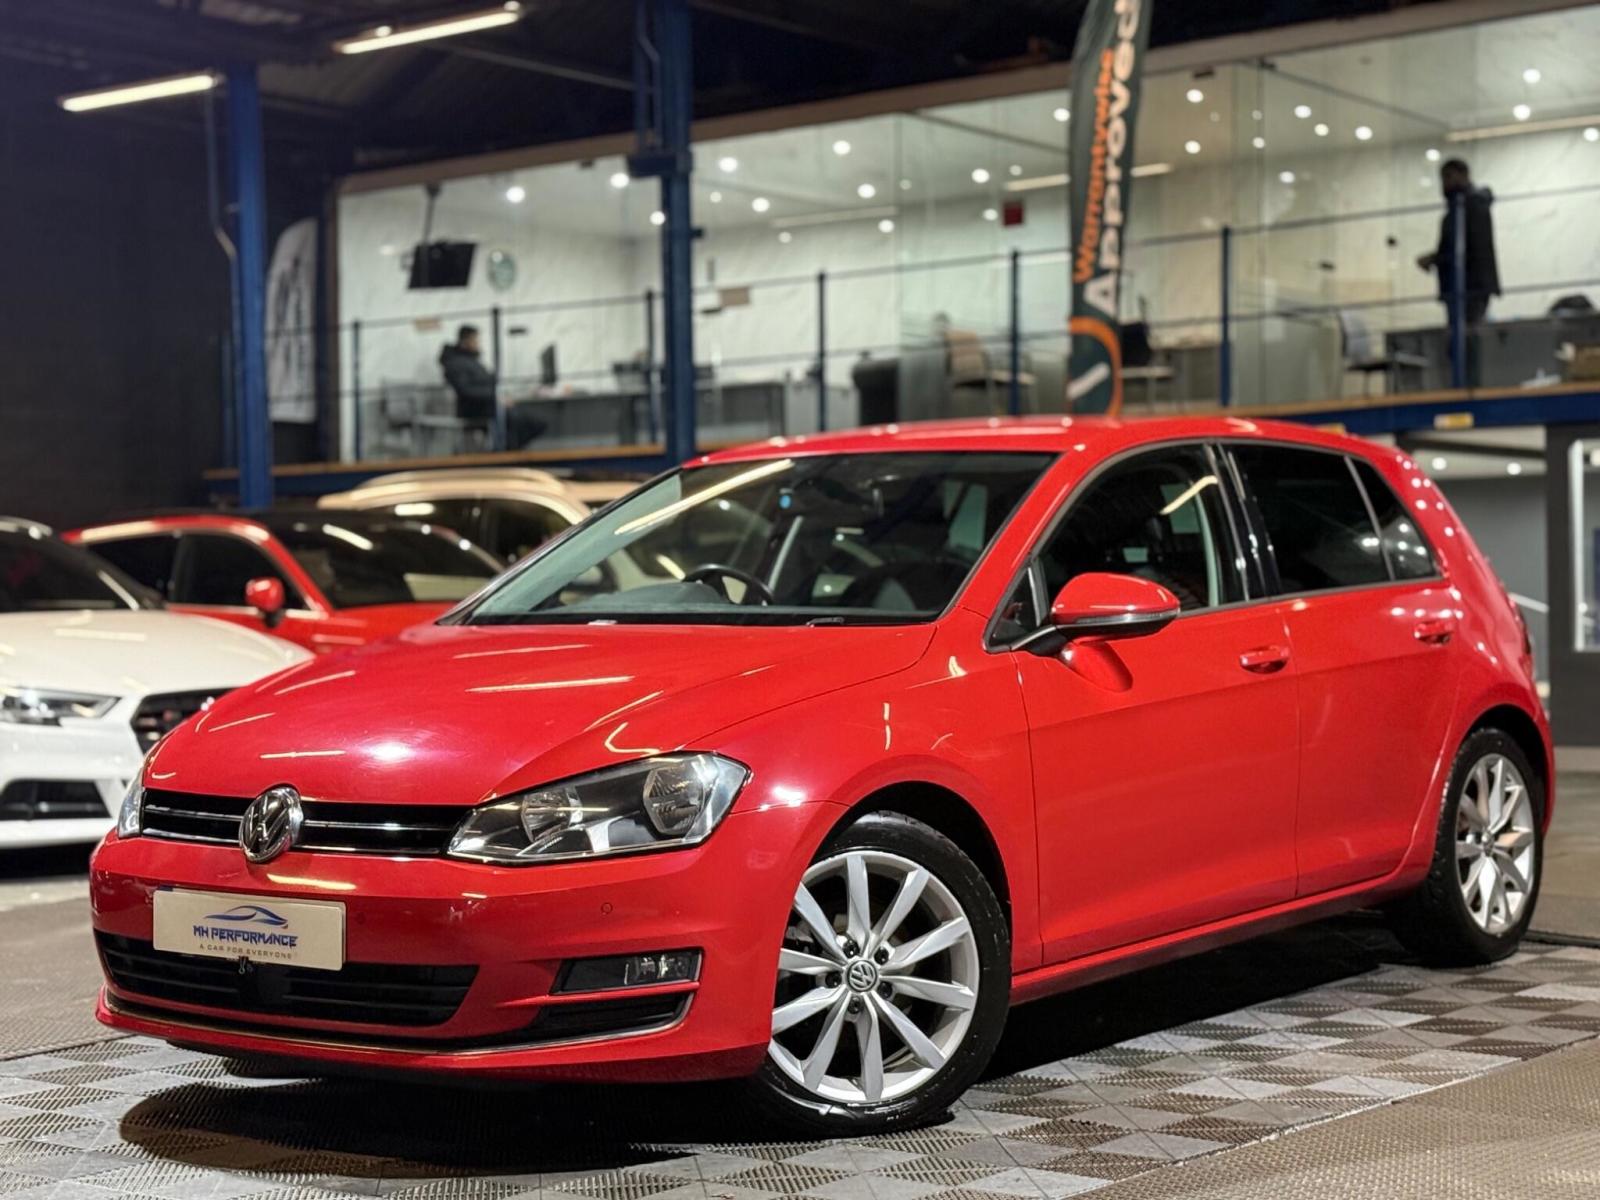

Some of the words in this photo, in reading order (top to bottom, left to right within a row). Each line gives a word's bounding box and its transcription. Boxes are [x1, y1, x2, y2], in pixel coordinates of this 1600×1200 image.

[1083, 0, 1140, 318] Approved
[211, 928, 298, 948] PERFORMANCE
[227, 946, 243, 954] FOR
[246, 949, 292, 959] EVERYONE
